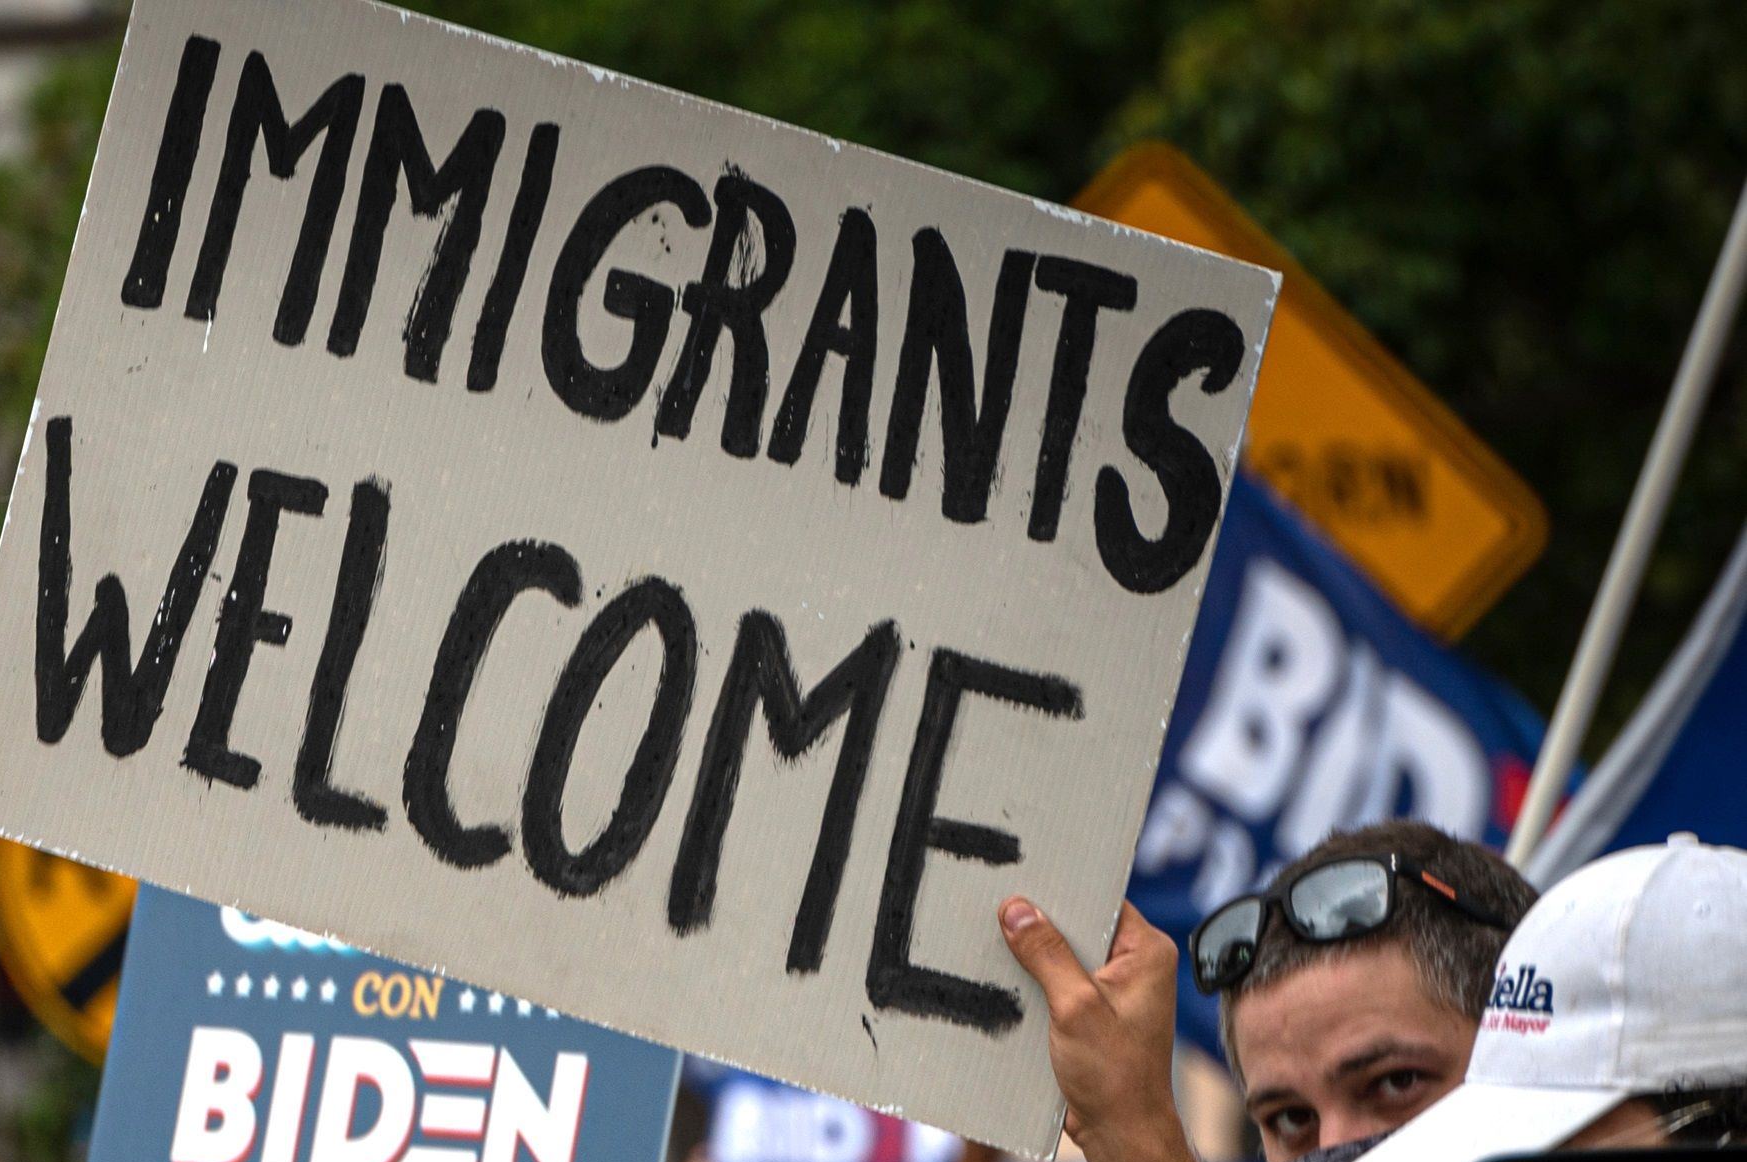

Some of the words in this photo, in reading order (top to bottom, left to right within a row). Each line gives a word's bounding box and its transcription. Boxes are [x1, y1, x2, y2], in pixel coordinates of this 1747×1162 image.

[121, 33, 1246, 595] IMMIGRANTS
[34, 415, 1086, 1035] WELCOME
[352, 969, 445, 1019] CON
